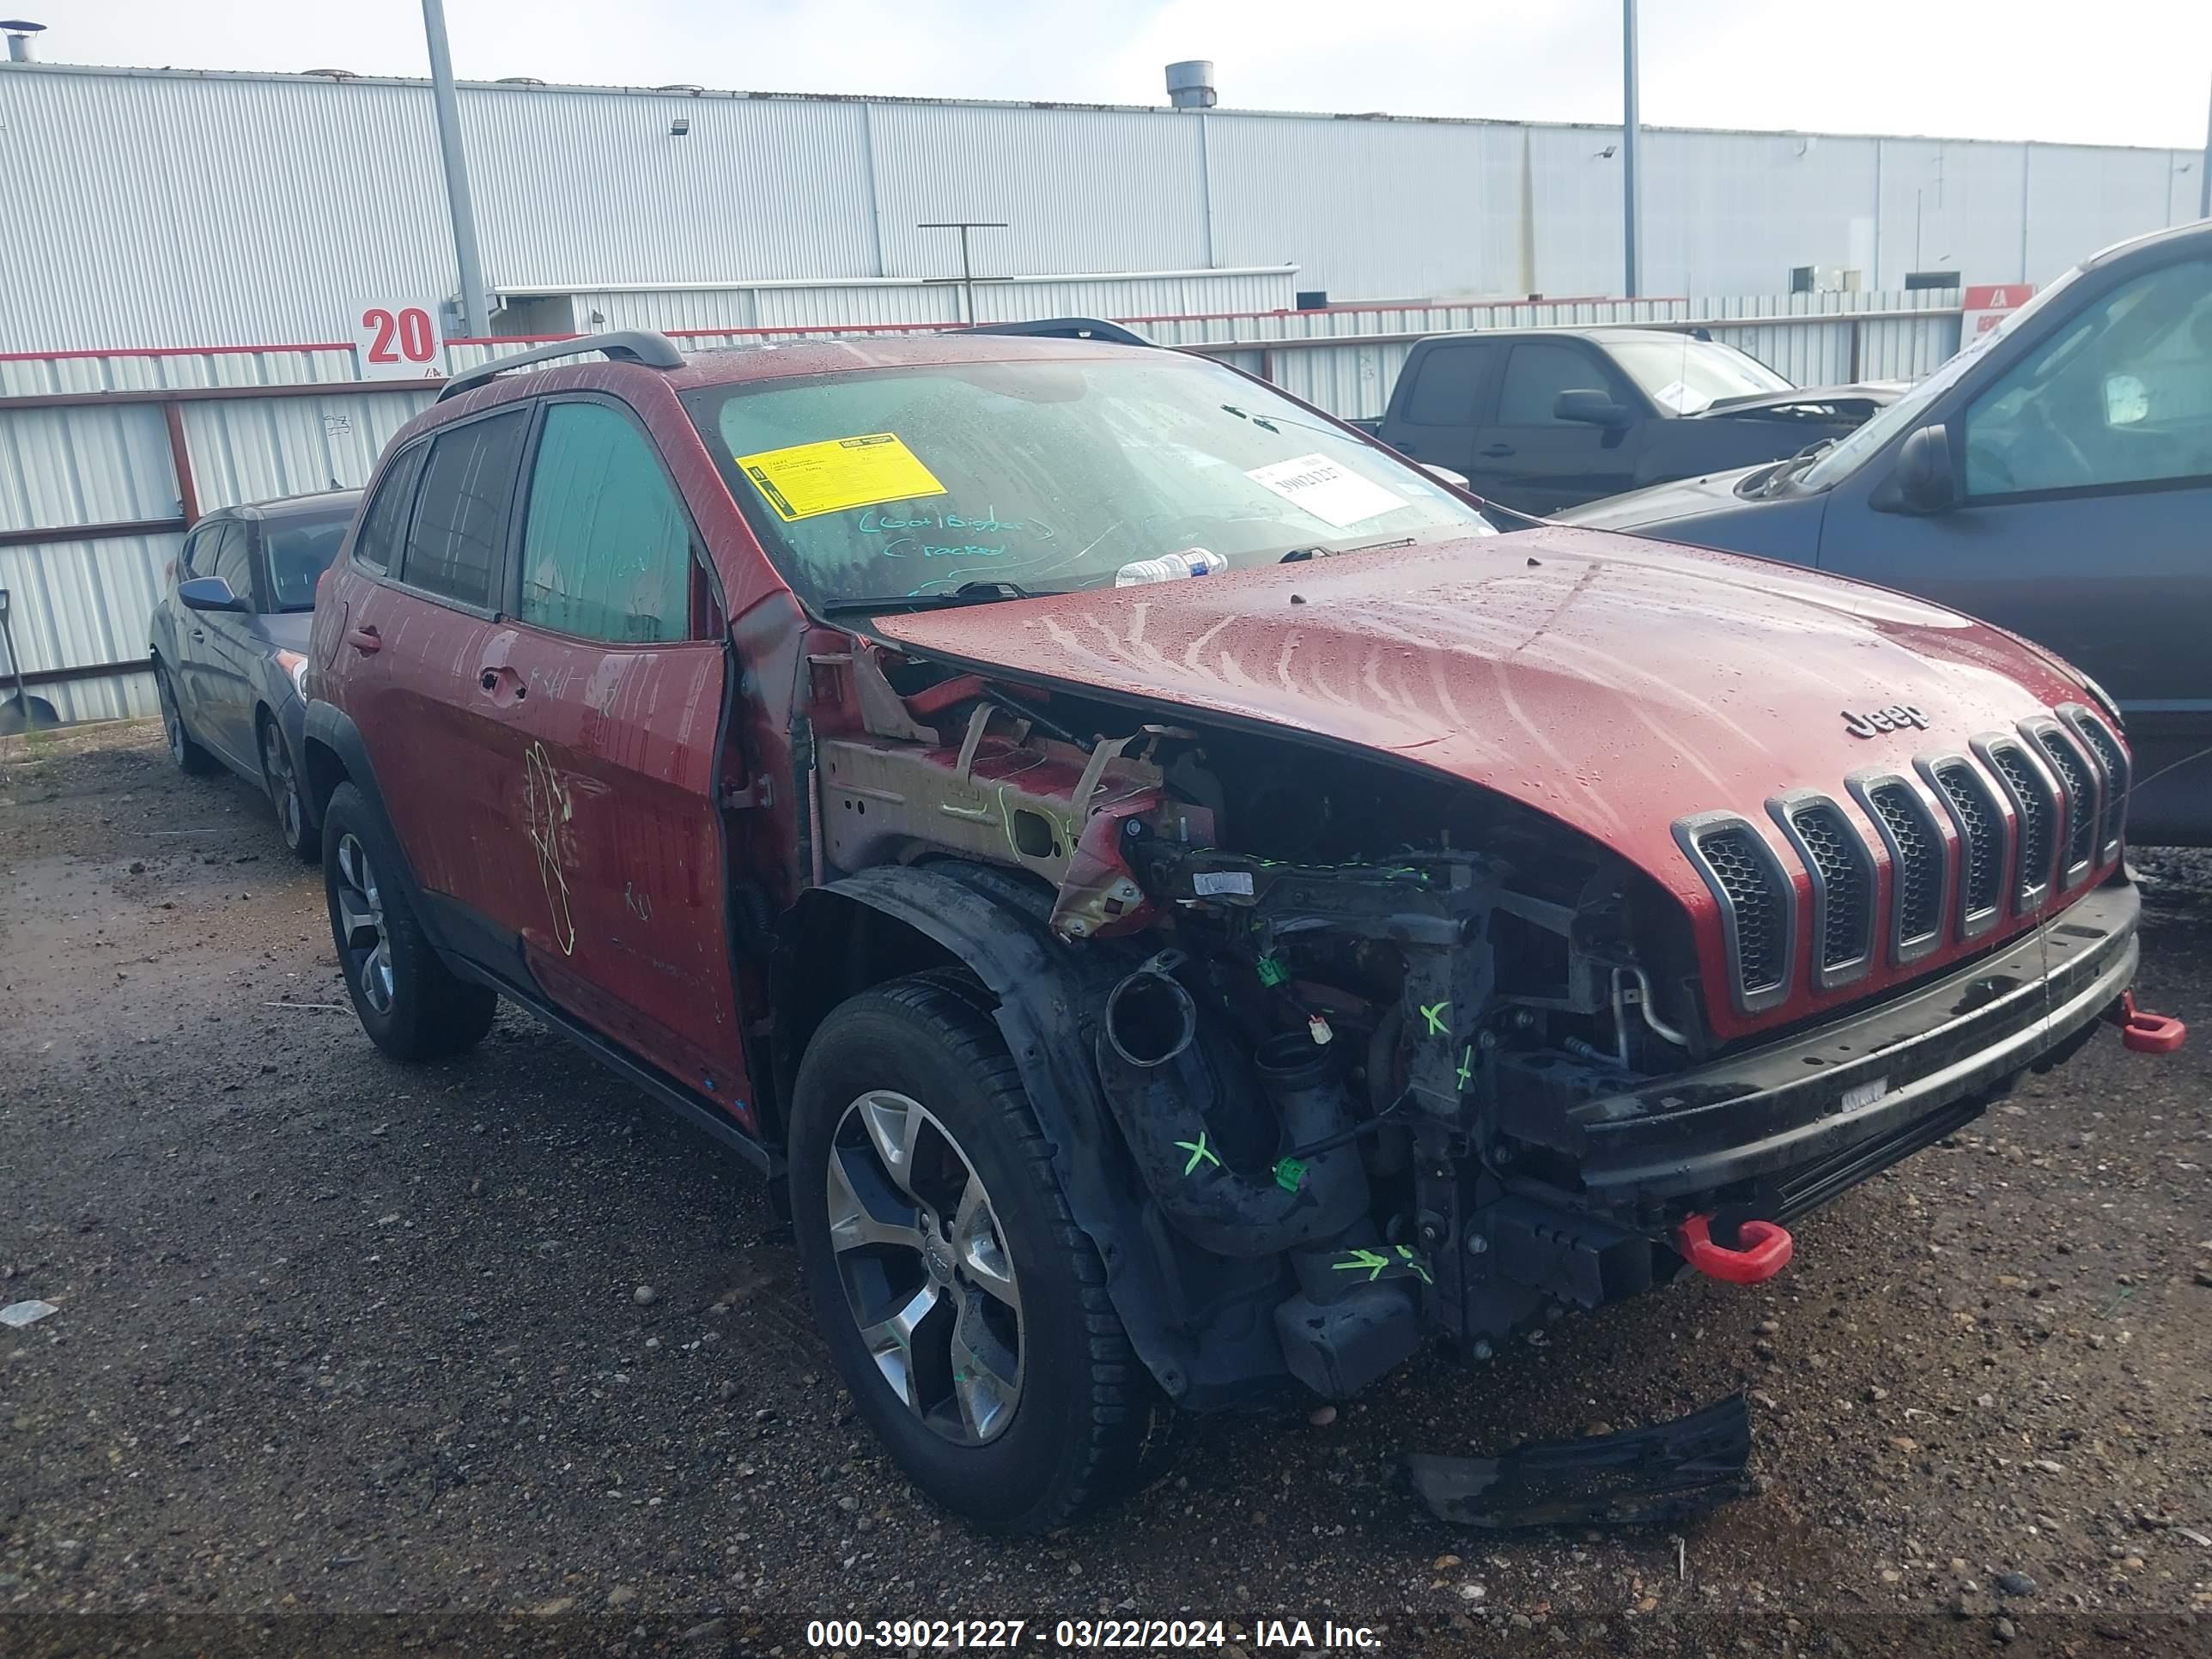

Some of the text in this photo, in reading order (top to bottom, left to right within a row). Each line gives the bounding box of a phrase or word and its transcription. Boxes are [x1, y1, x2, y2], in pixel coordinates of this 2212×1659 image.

[362, 307, 436, 364] 20
[1275, 467, 1341, 493] 39021227
[1839, 704, 1930, 740] Jeep
